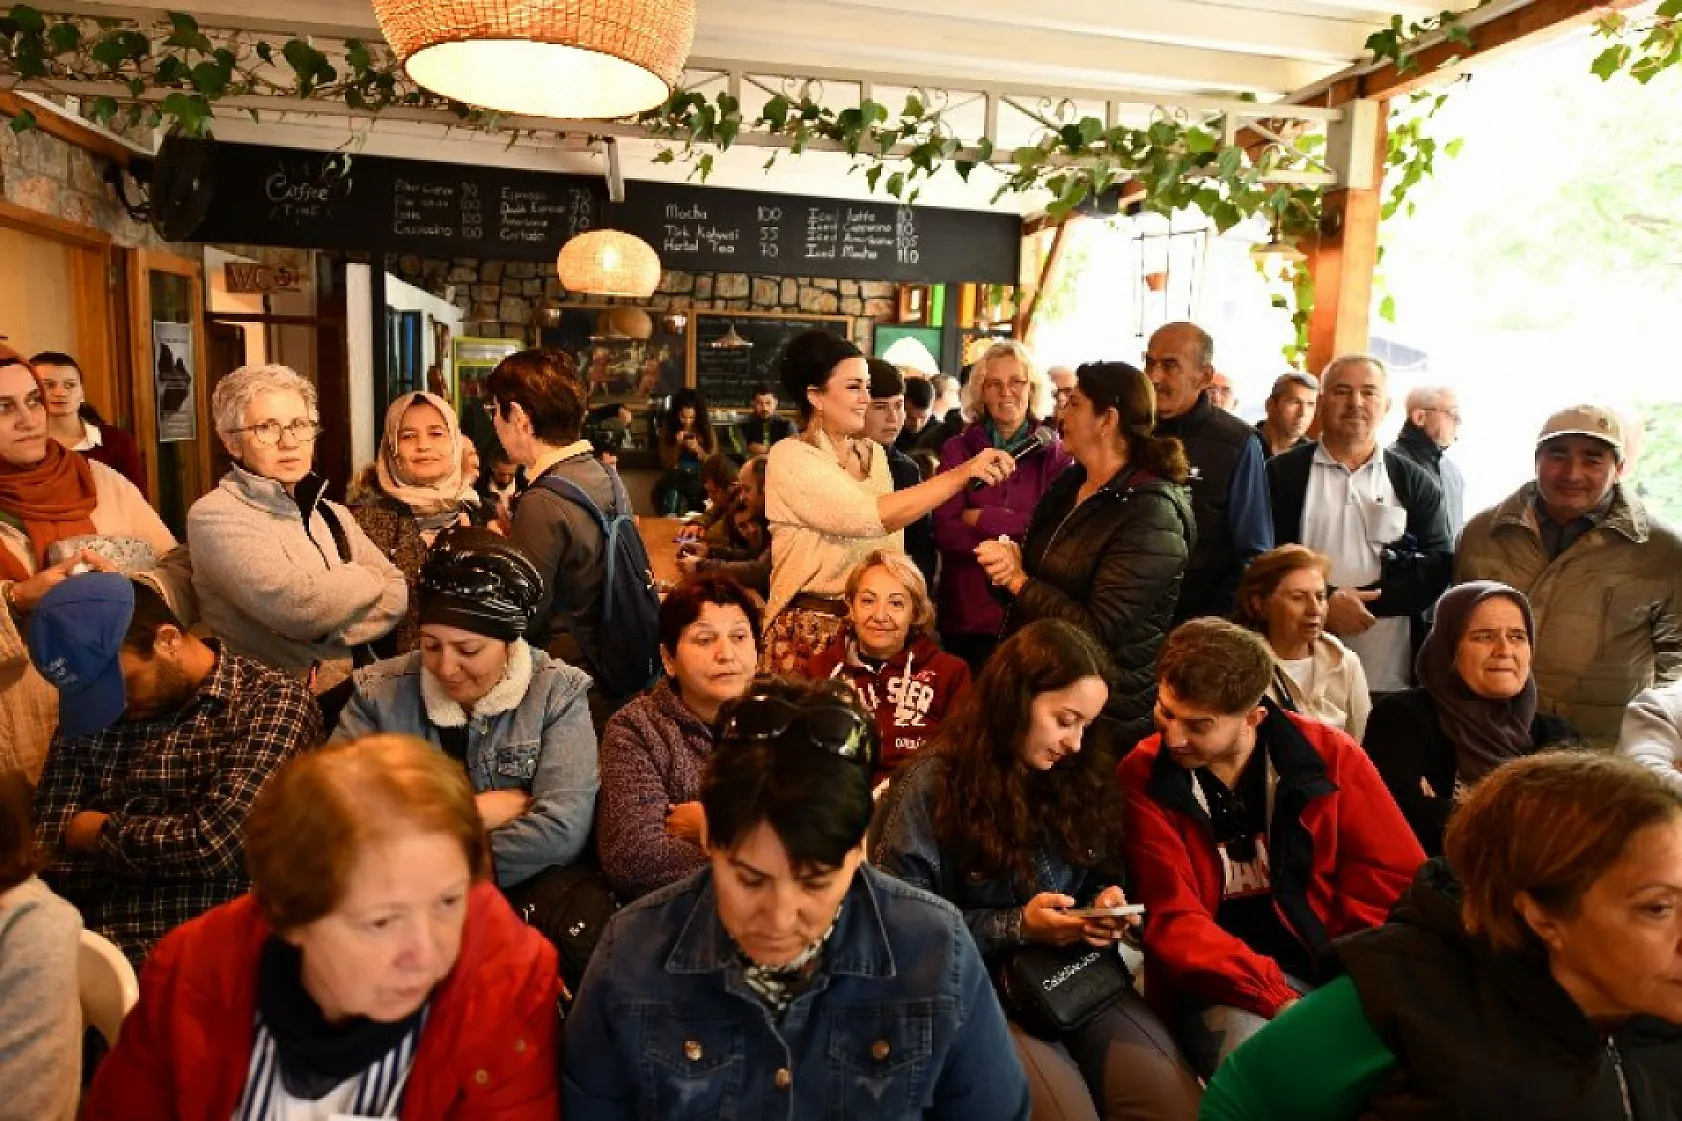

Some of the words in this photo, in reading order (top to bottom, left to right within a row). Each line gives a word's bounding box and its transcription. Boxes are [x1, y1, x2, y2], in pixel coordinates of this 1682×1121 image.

[665, 203, 707, 220] Mocha
[757, 205, 783, 221] 100
[229, 264, 271, 290] WC
